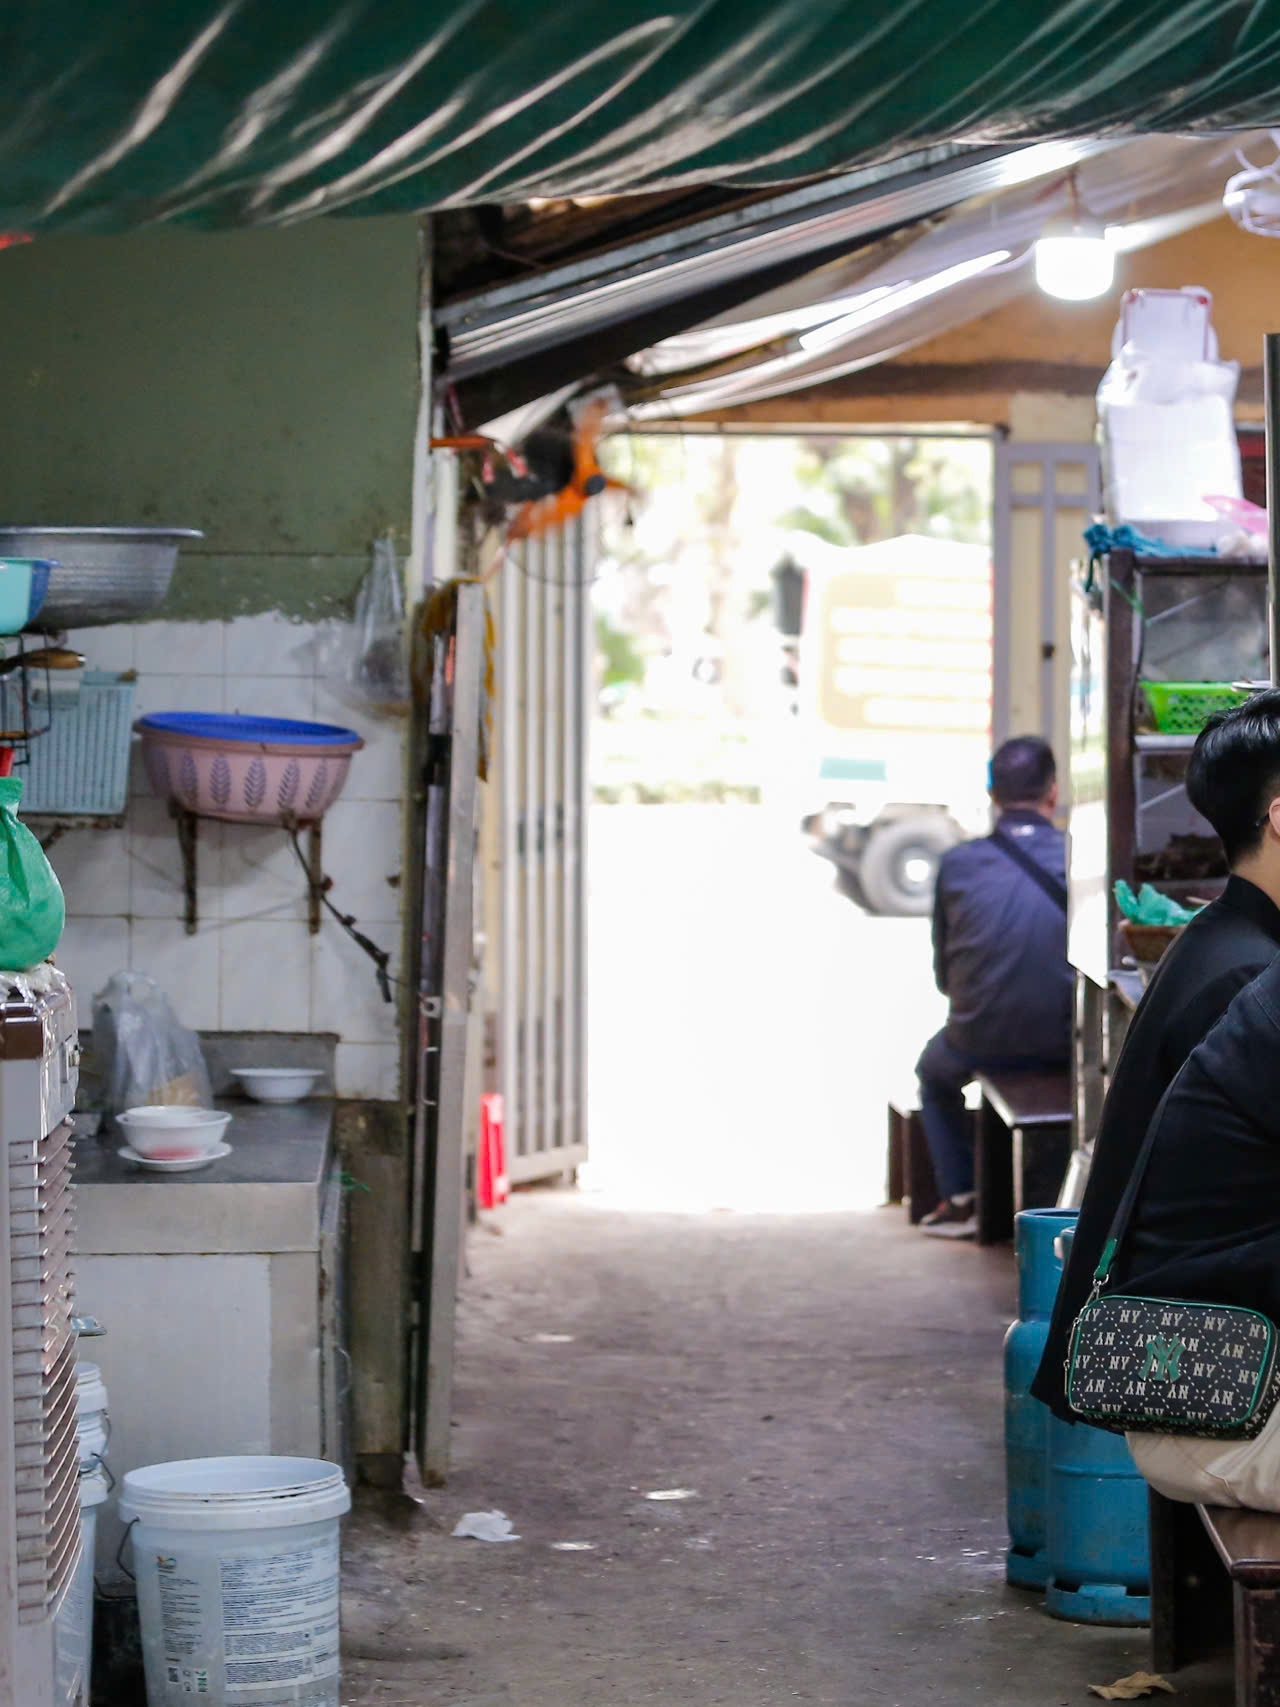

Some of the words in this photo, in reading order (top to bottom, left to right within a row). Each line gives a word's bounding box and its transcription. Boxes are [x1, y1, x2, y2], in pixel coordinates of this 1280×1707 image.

[1120, 1309, 1141, 1324] NY
[1161, 1312, 1183, 1326] NY
[1204, 1316, 1226, 1332] NY
[1109, 1355, 1130, 1370] NY
[1193, 1362, 1216, 1378] NY
[1238, 1369, 1259, 1386] NY
